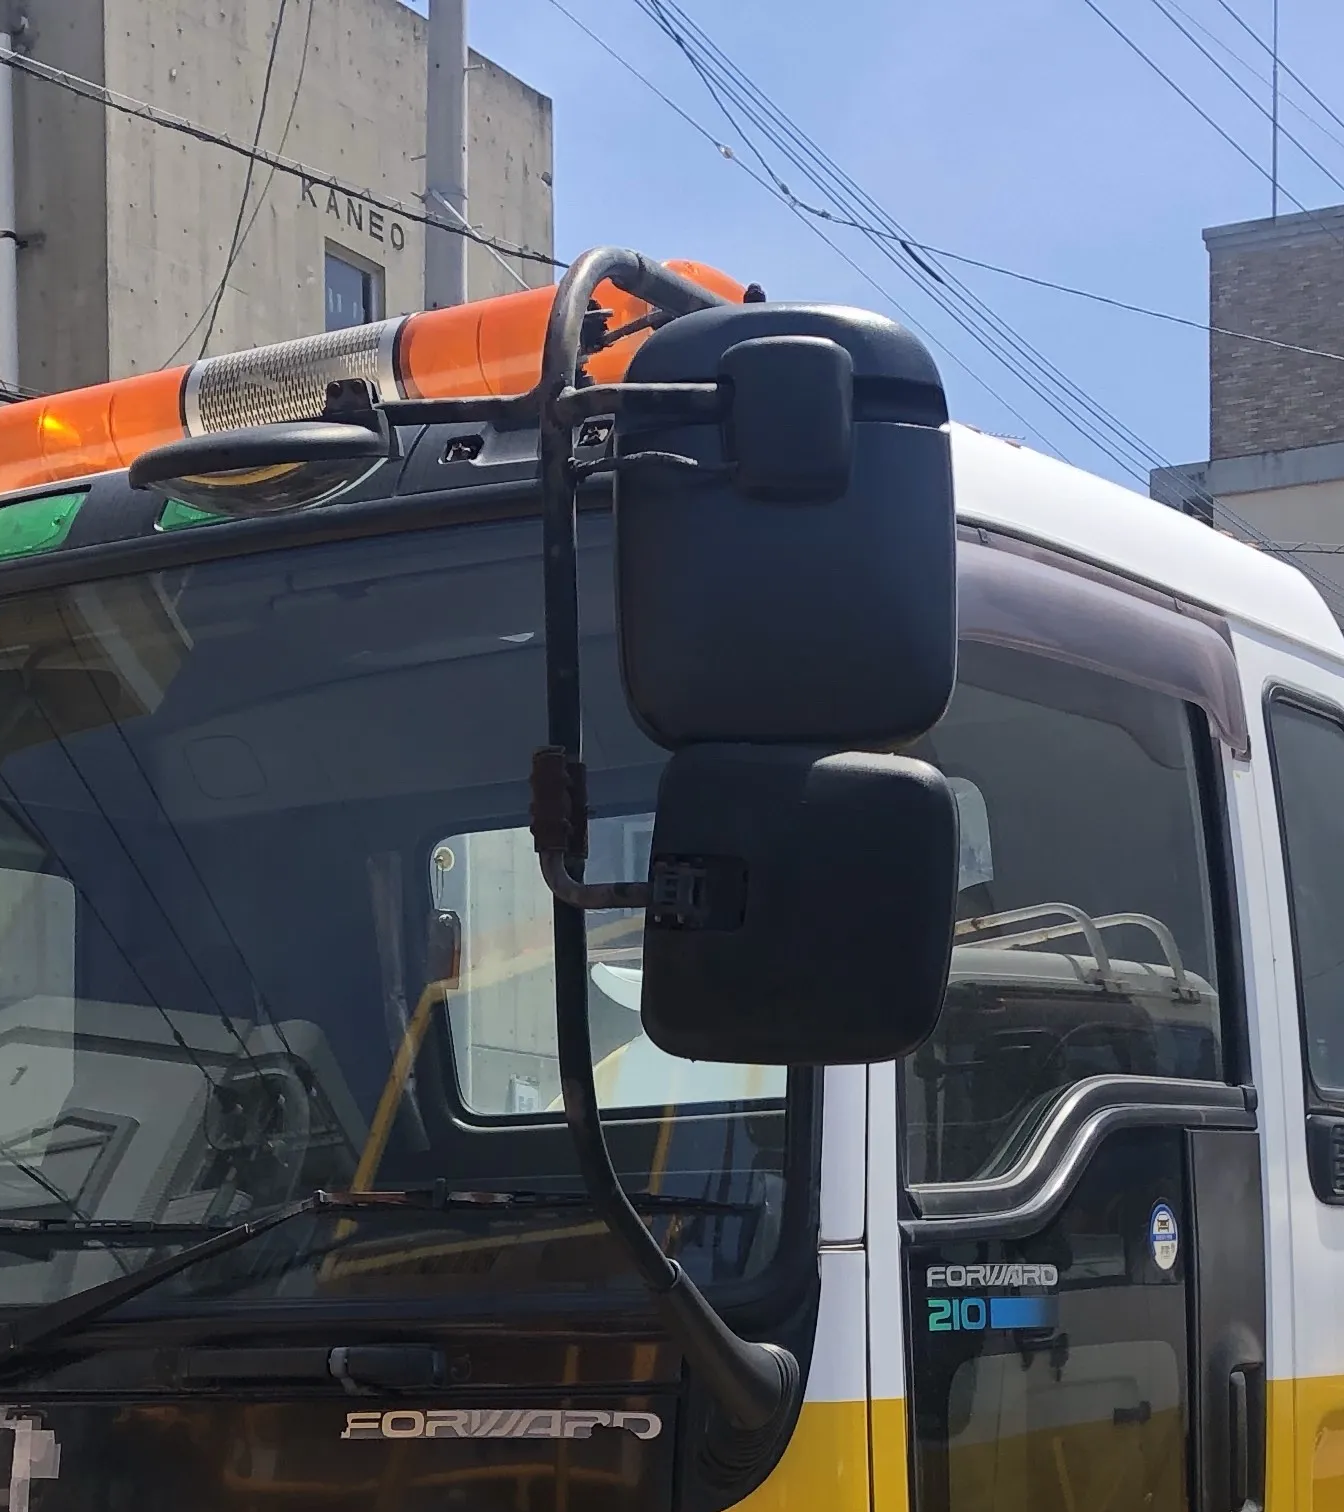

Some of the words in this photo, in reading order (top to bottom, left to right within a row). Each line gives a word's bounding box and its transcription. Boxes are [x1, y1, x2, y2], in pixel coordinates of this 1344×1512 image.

[301, 174, 405, 251] KANEO
[926, 1264, 1058, 1288] FORWARD
[928, 1299, 987, 1331] 210
[343, 1410, 663, 1439] FORWARD
